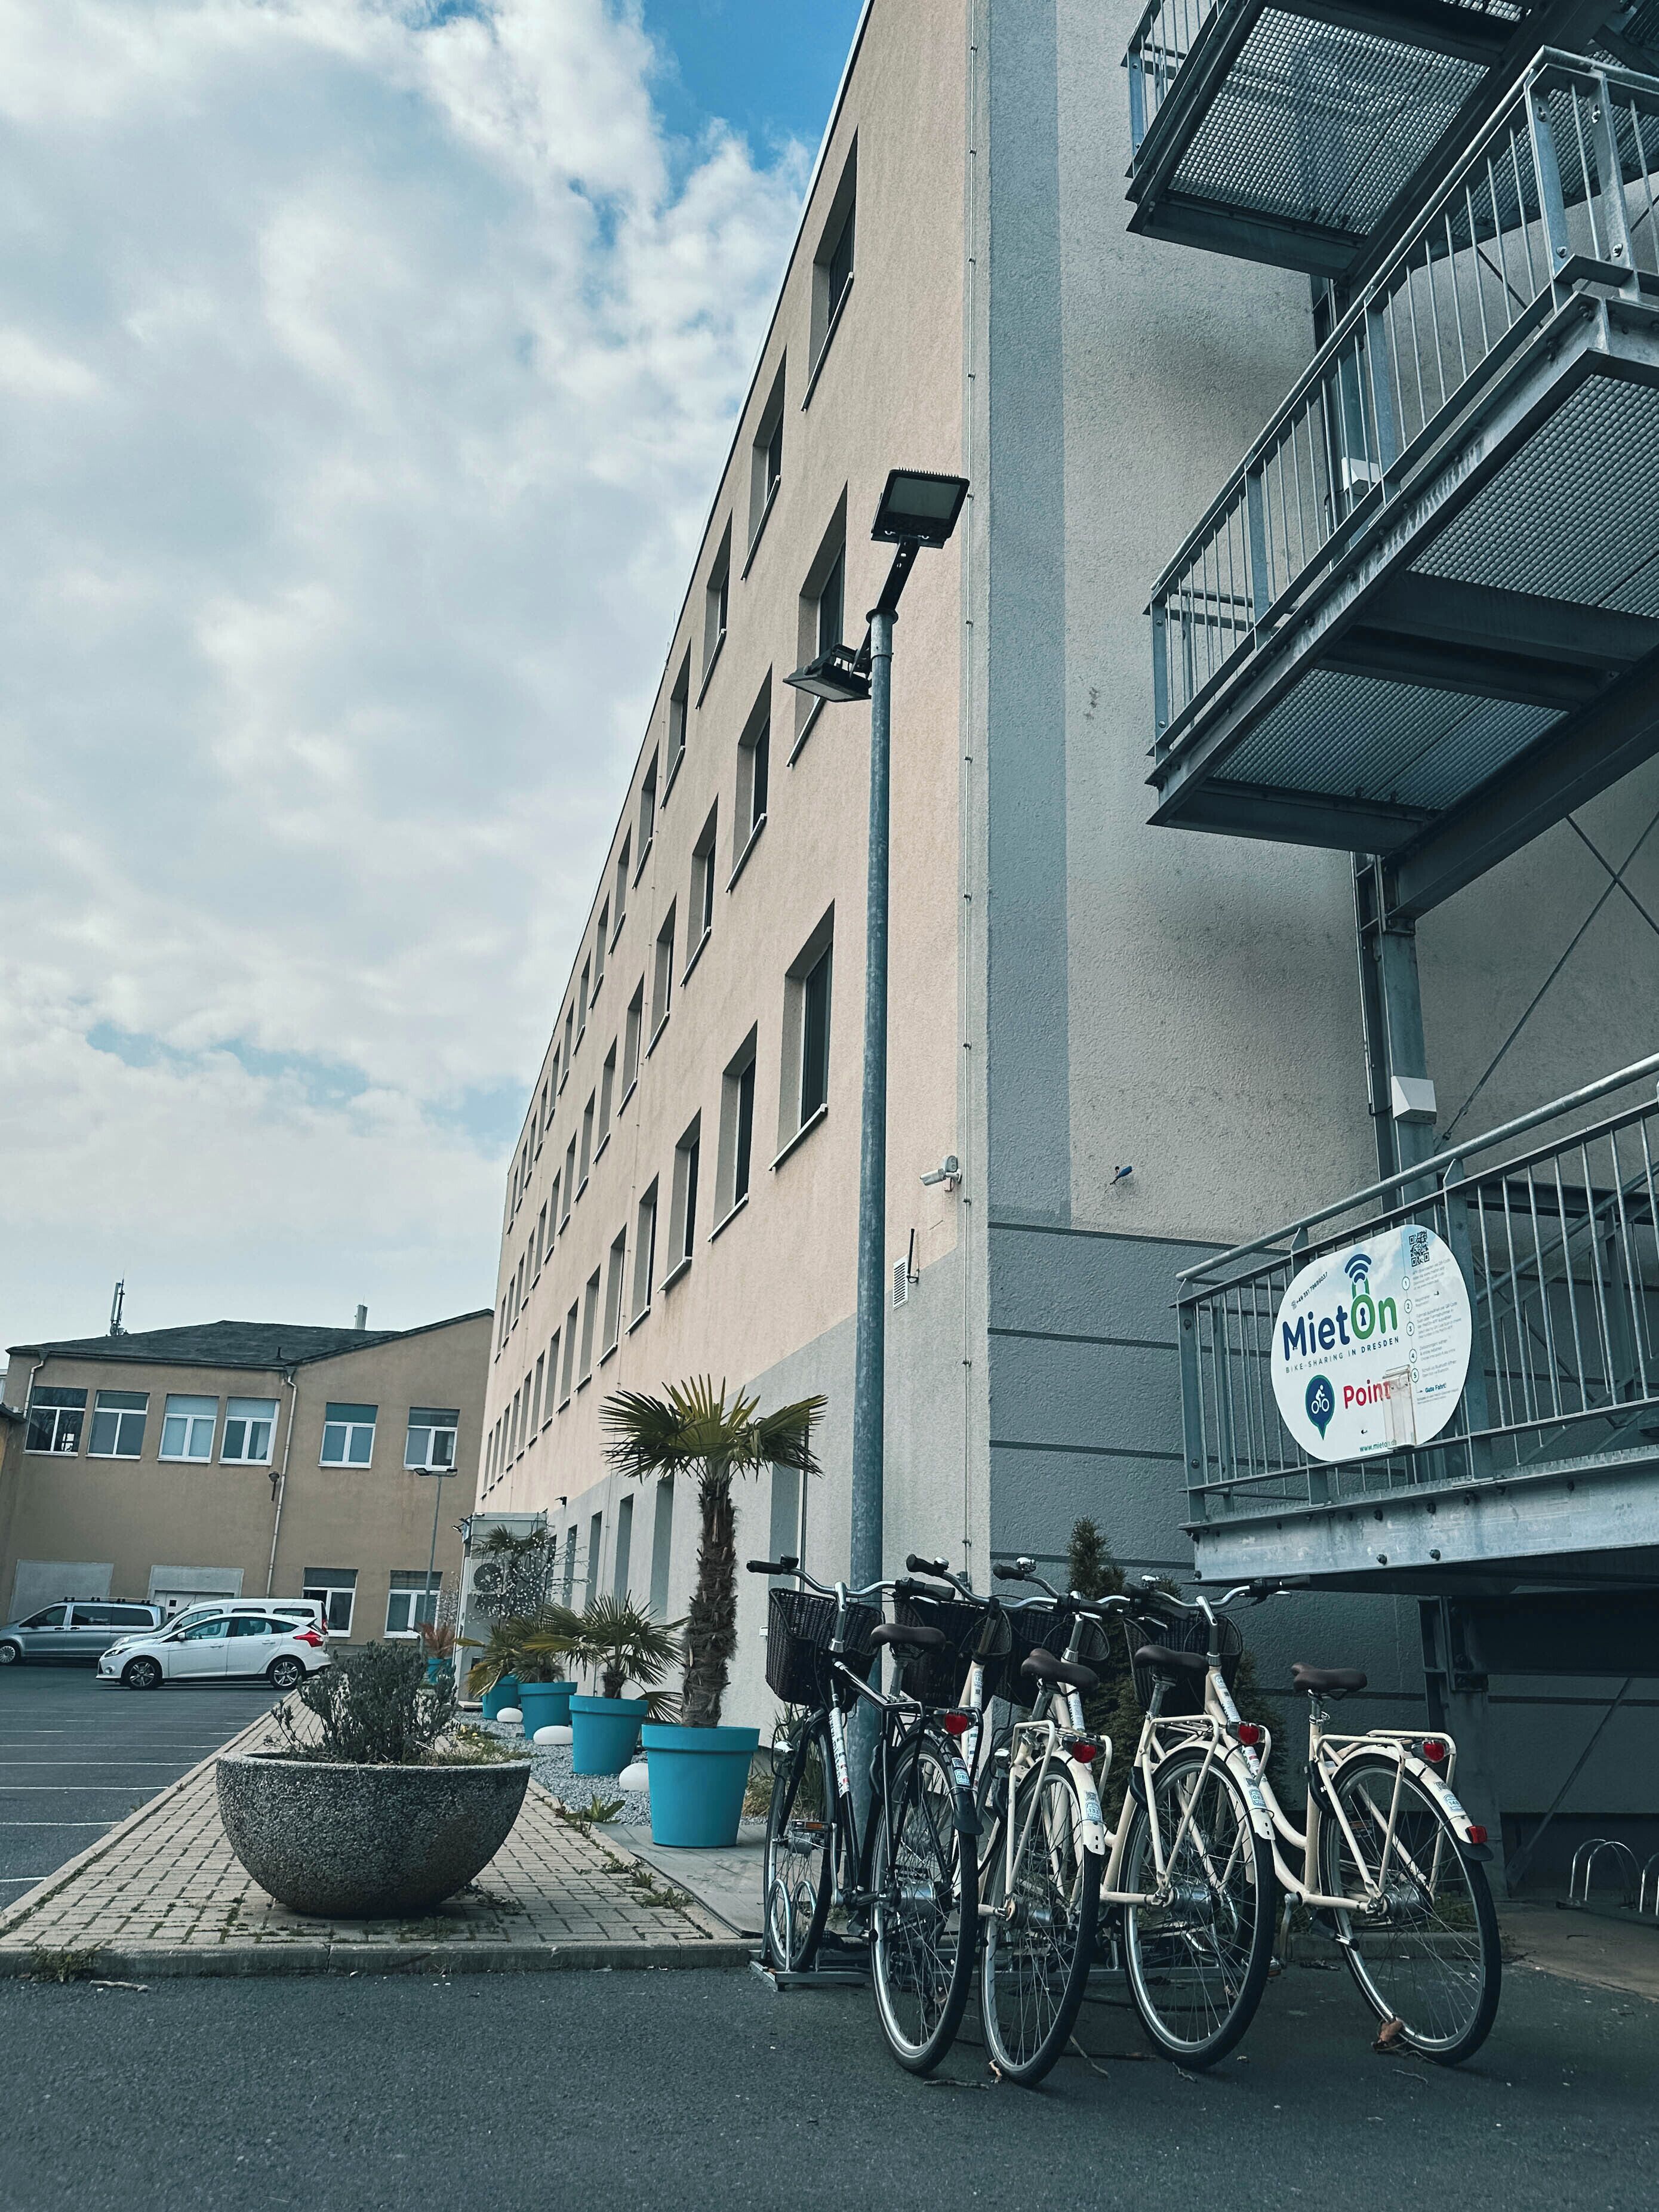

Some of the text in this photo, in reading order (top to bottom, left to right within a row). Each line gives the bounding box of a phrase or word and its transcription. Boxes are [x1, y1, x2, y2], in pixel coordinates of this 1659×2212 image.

[1282, 1293, 1398, 1361] MietOn
[1348, 1348, 1356, 1357] IN
[1361, 1336, 1399, 1353] DRESDEN
